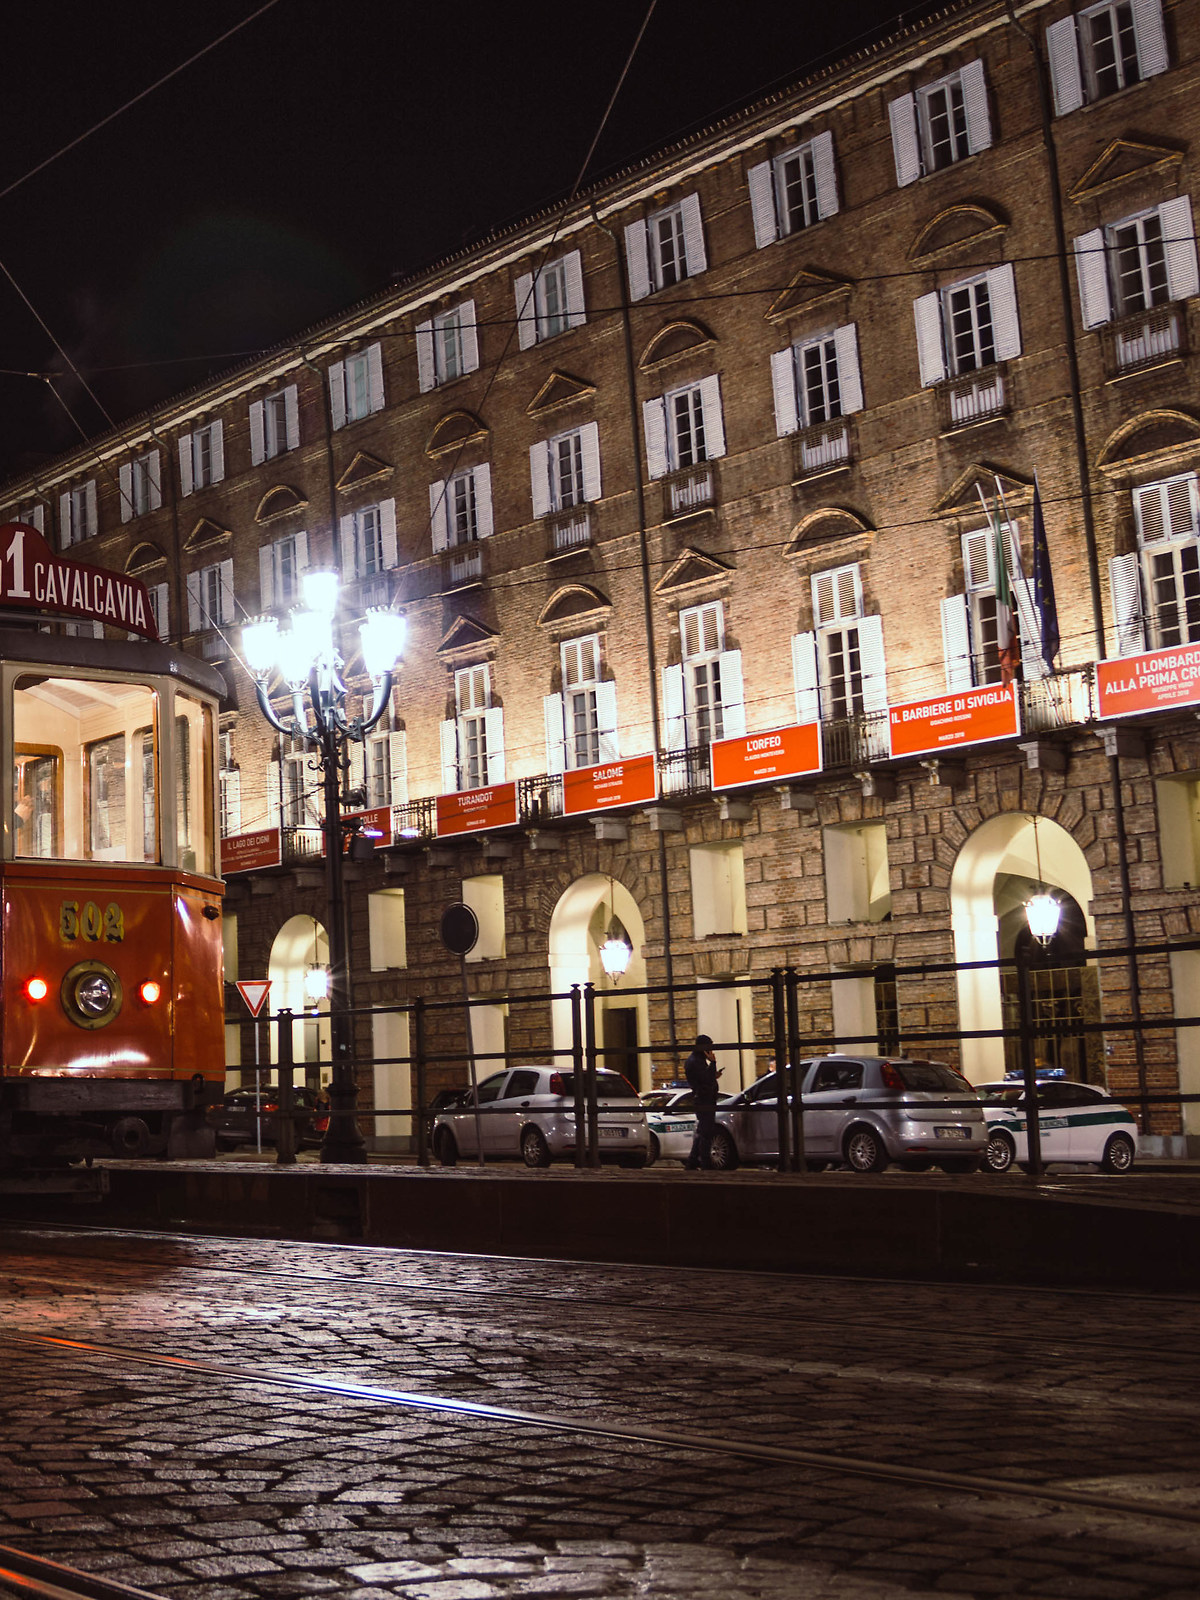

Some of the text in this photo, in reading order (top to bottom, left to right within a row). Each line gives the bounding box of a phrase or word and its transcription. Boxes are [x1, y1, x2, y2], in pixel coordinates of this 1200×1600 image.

[6, 530, 31, 598] 1
[34, 561, 148, 630] CAVALCAVIA
[1135, 662, 1140, 675] I
[1105, 678, 1137, 695] ALLA
[1139, 670, 1179, 689] PRIMA
[891, 690, 1013, 724] IL BARBIERE DI SIVIGLIA
[746, 735, 781, 752] L'ORFEO
[592, 766, 624, 781] SALOME
[457, 791, 494, 807] TURANDOT
[59, 900, 125, 945] 502
